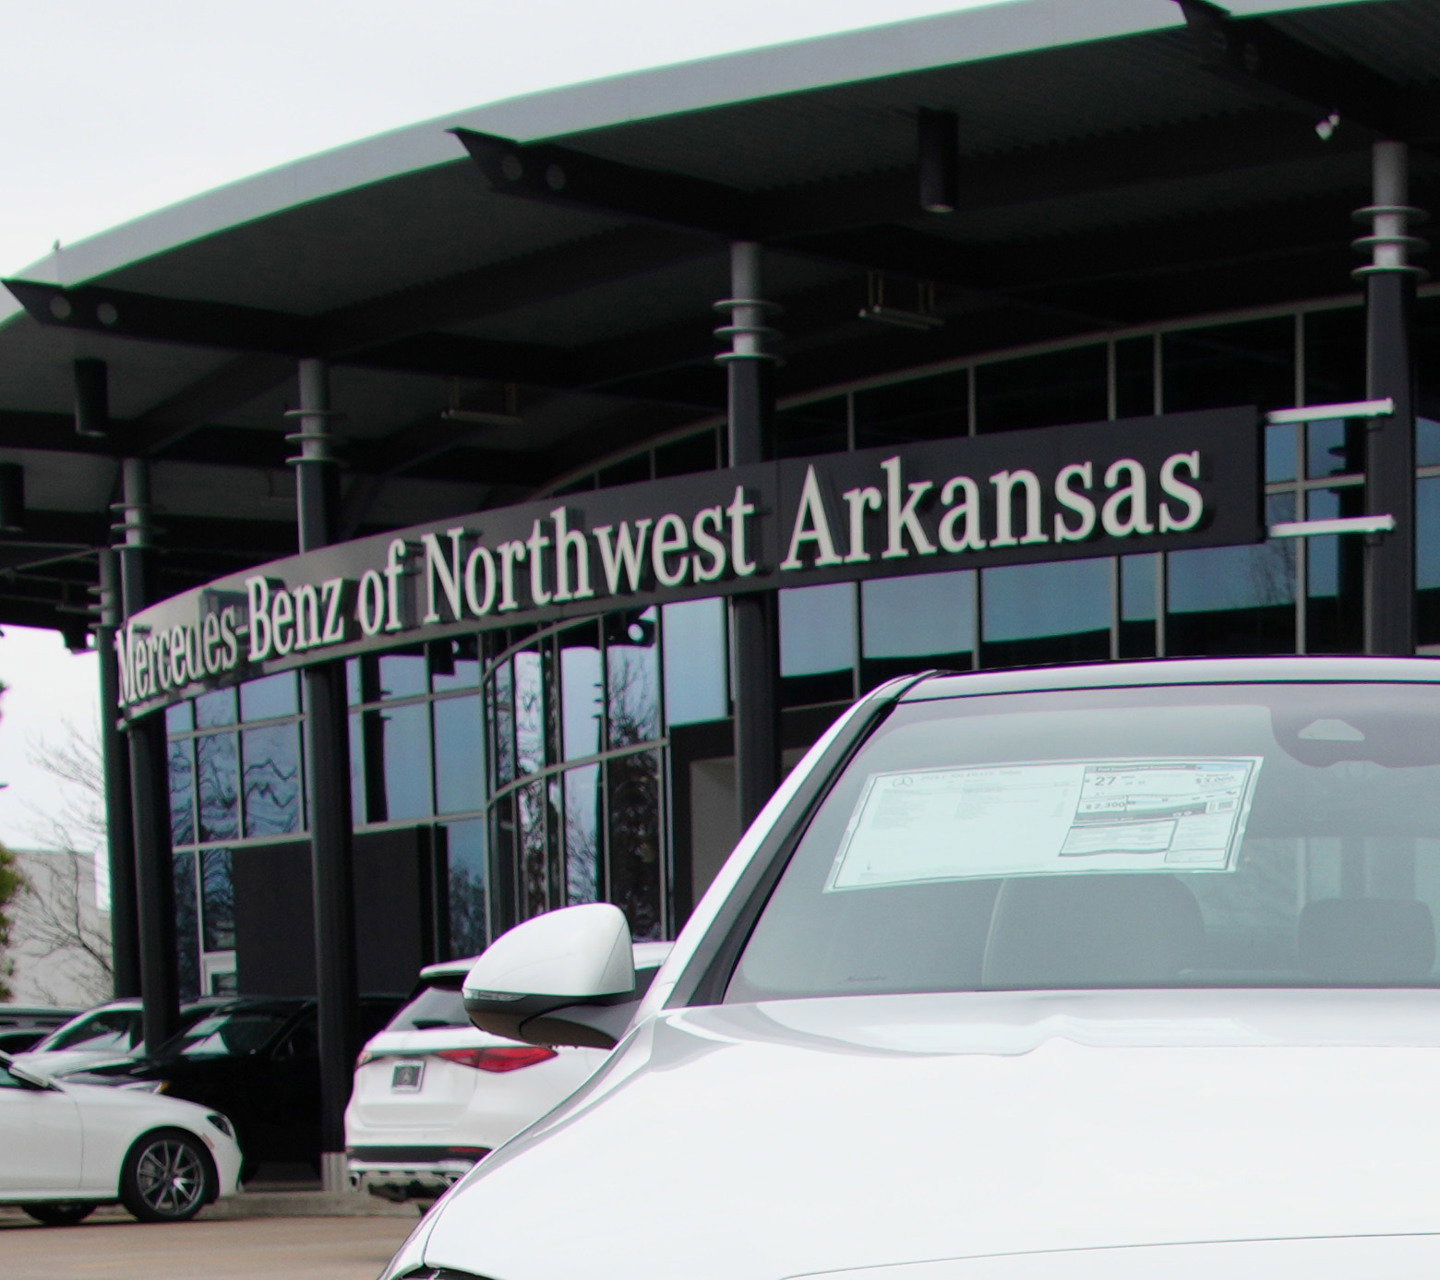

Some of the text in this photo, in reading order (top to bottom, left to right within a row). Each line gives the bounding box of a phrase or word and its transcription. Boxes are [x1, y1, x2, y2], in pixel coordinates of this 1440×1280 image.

[115, 450, 1204, 706] Mercedes-Benz of Northwest Arkansas
